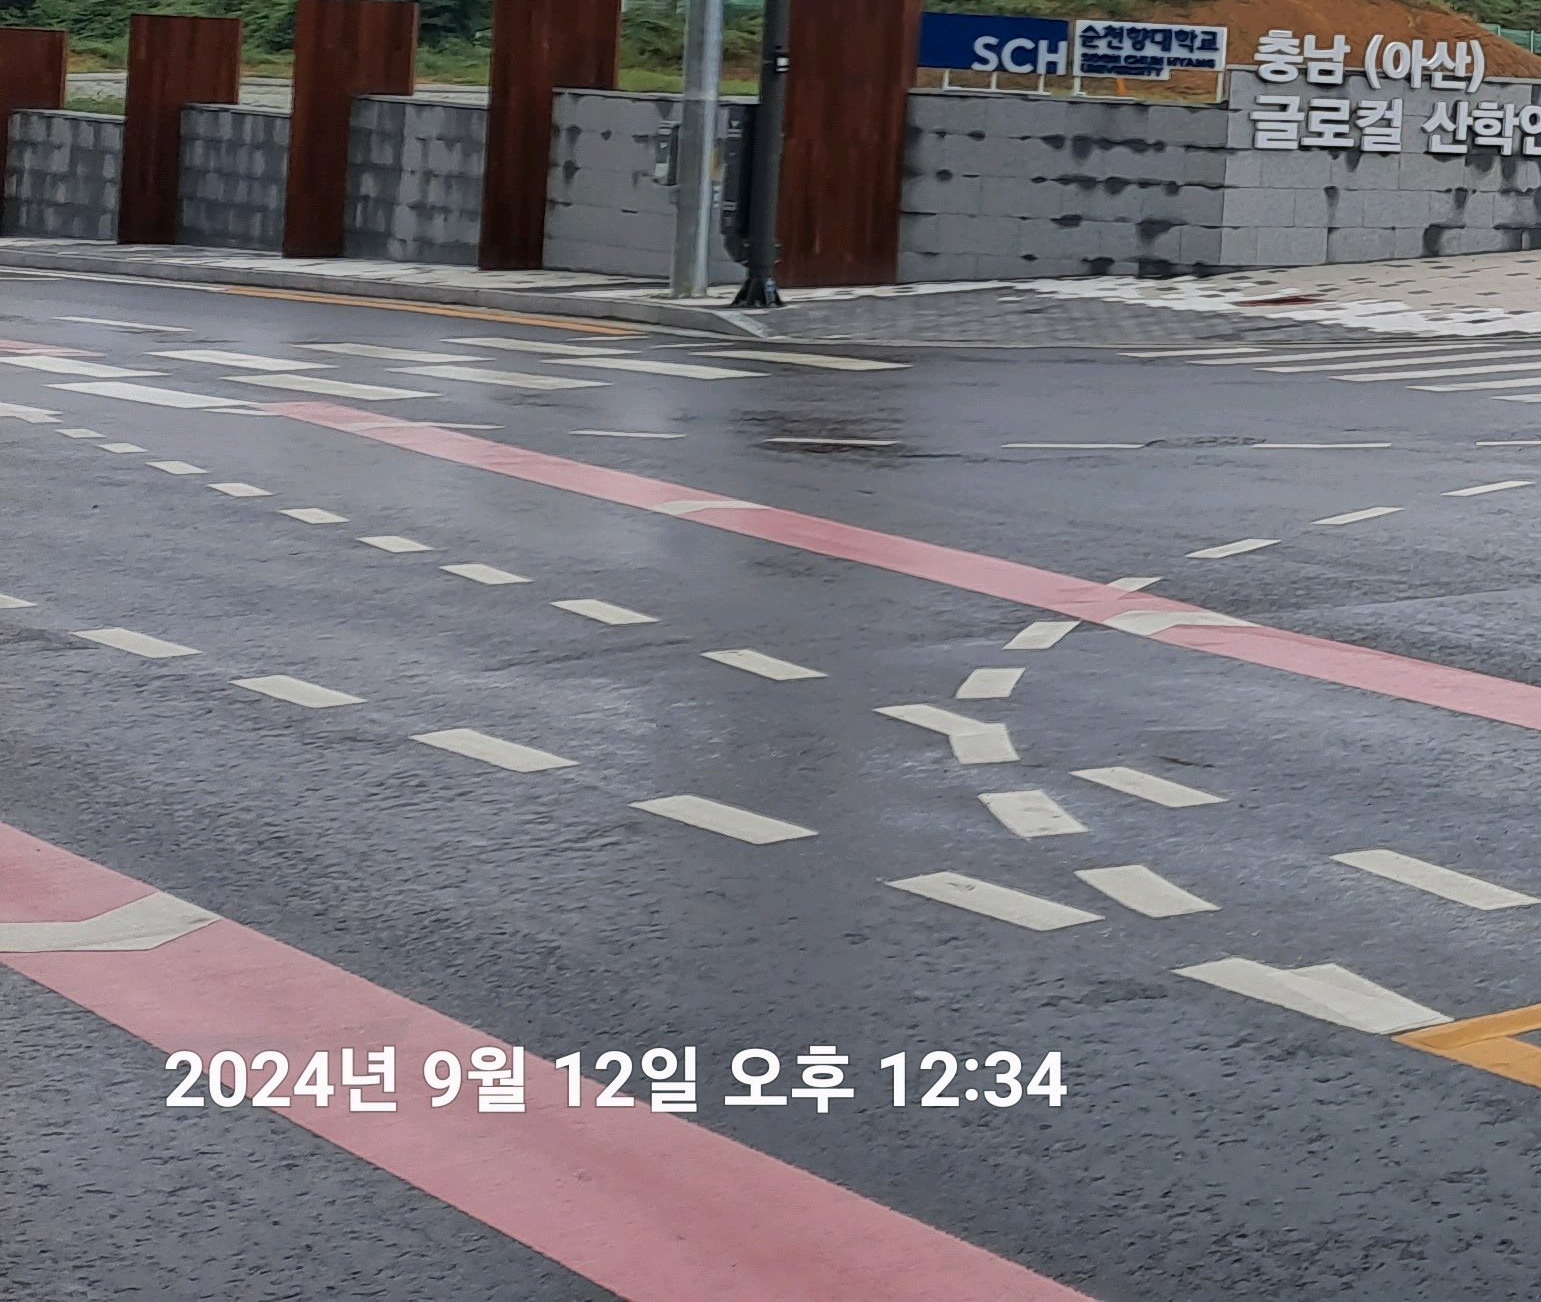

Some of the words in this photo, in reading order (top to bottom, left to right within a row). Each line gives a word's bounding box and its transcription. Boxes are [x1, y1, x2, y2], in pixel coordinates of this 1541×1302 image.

[972, 36, 1067, 75] SCH
[1079, 24, 1220, 53] 순천향대학교
[1254, 29, 1351, 84] 충남
[1364, 34, 1485, 94] (아산)
[1250, 95, 1403, 152] 글로컬
